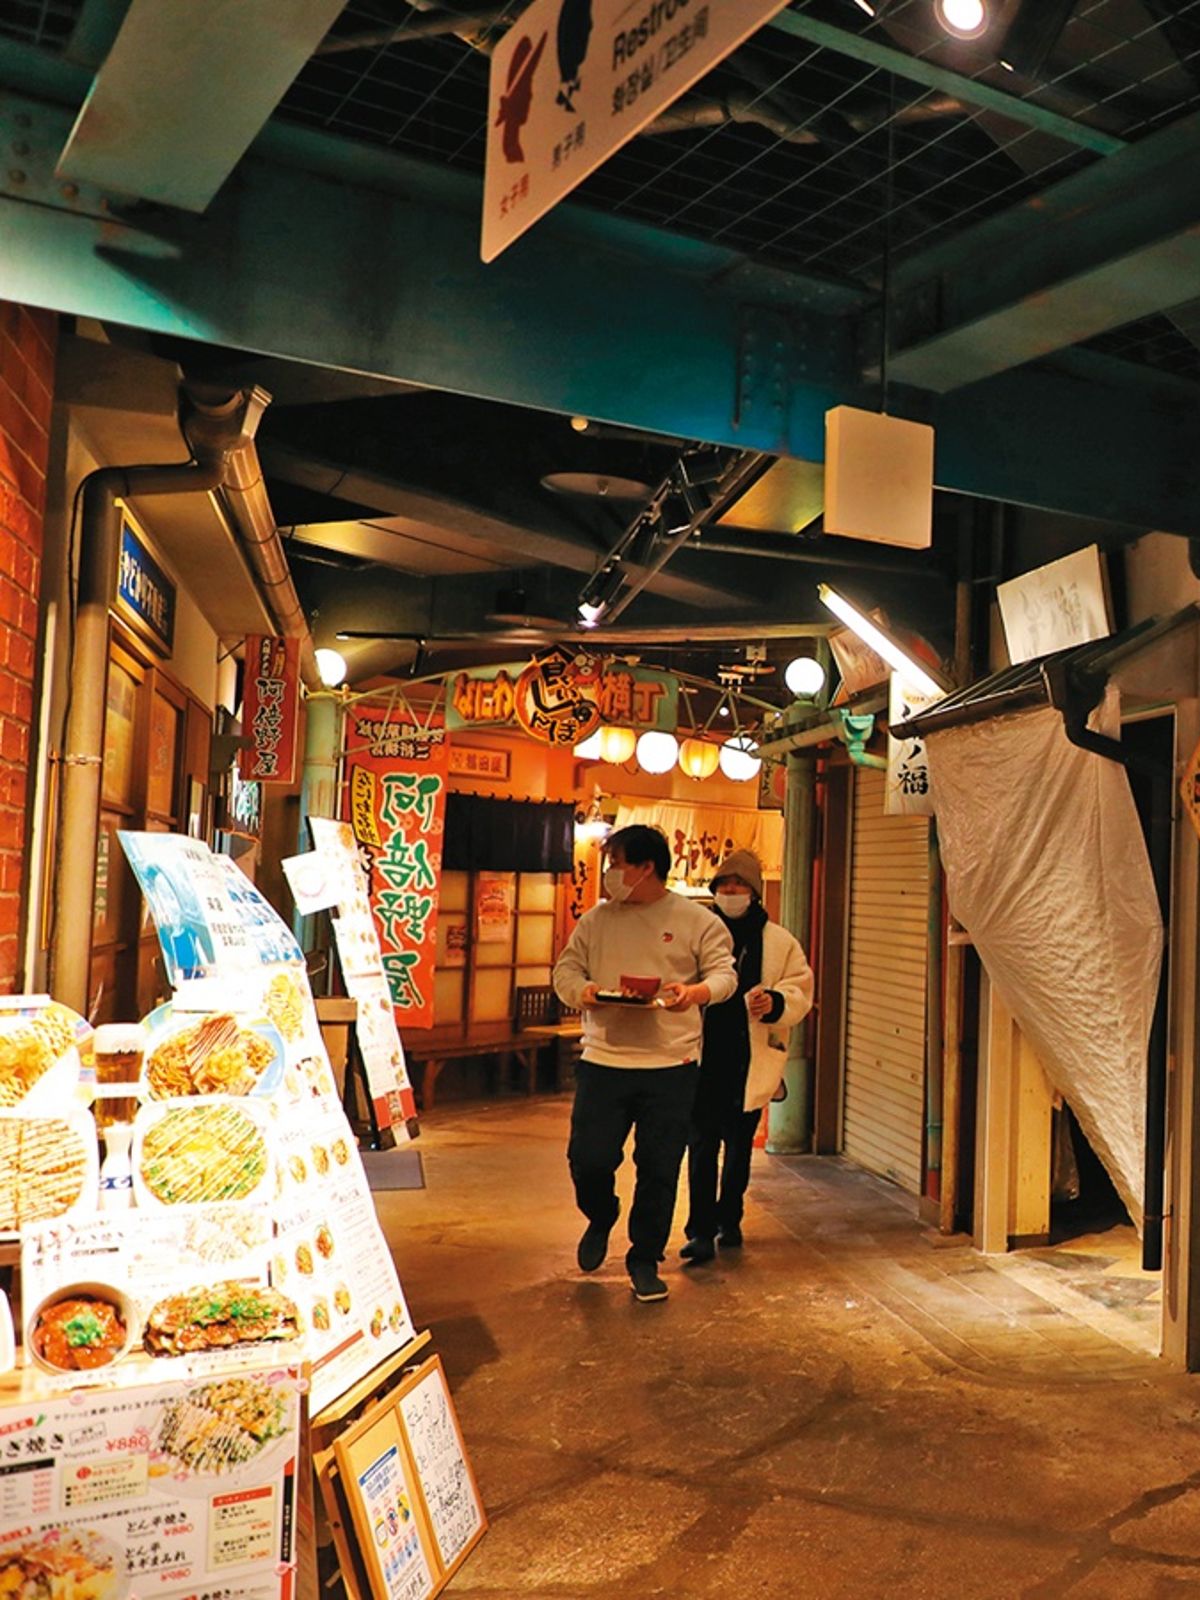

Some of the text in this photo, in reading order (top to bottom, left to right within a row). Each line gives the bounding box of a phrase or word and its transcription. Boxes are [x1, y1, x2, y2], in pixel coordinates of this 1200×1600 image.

[252, 677, 287, 776] 阿倍野屋
[602, 671, 665, 724] 横丁
